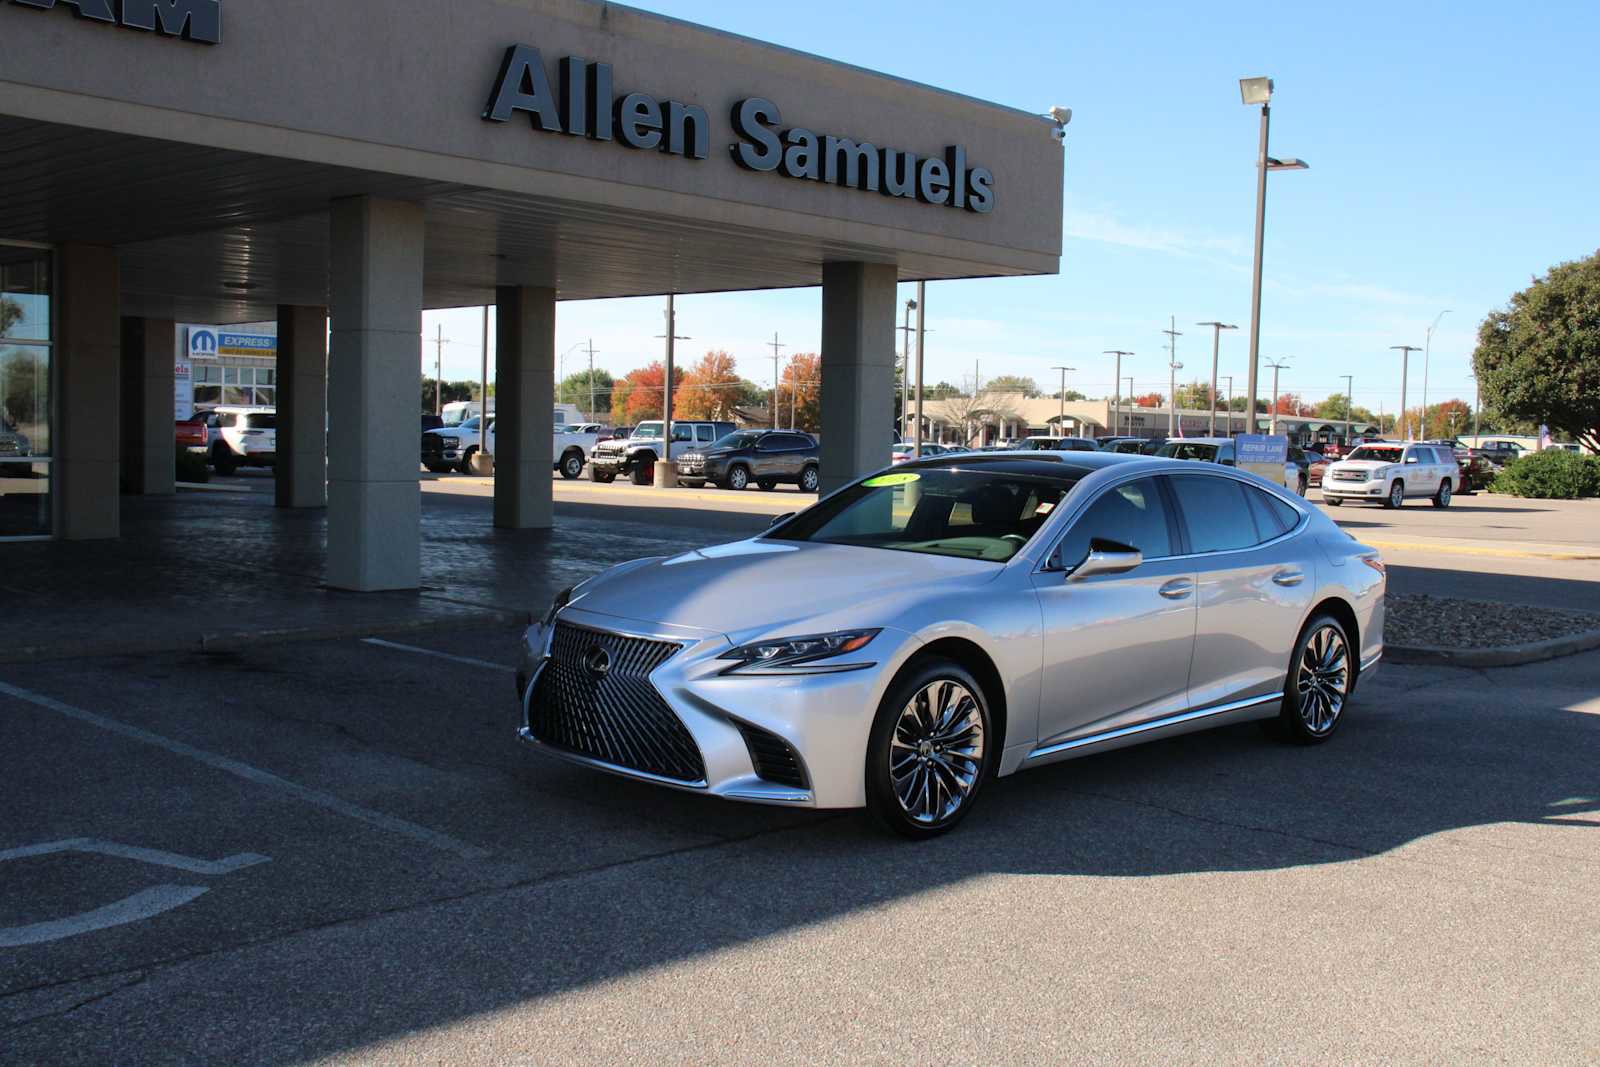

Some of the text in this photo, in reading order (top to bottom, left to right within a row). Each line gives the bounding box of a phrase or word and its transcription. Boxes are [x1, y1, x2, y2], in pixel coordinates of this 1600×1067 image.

[482, 43, 995, 213] Allen Samuels
[224, 336, 272, 348] EXPRESS
